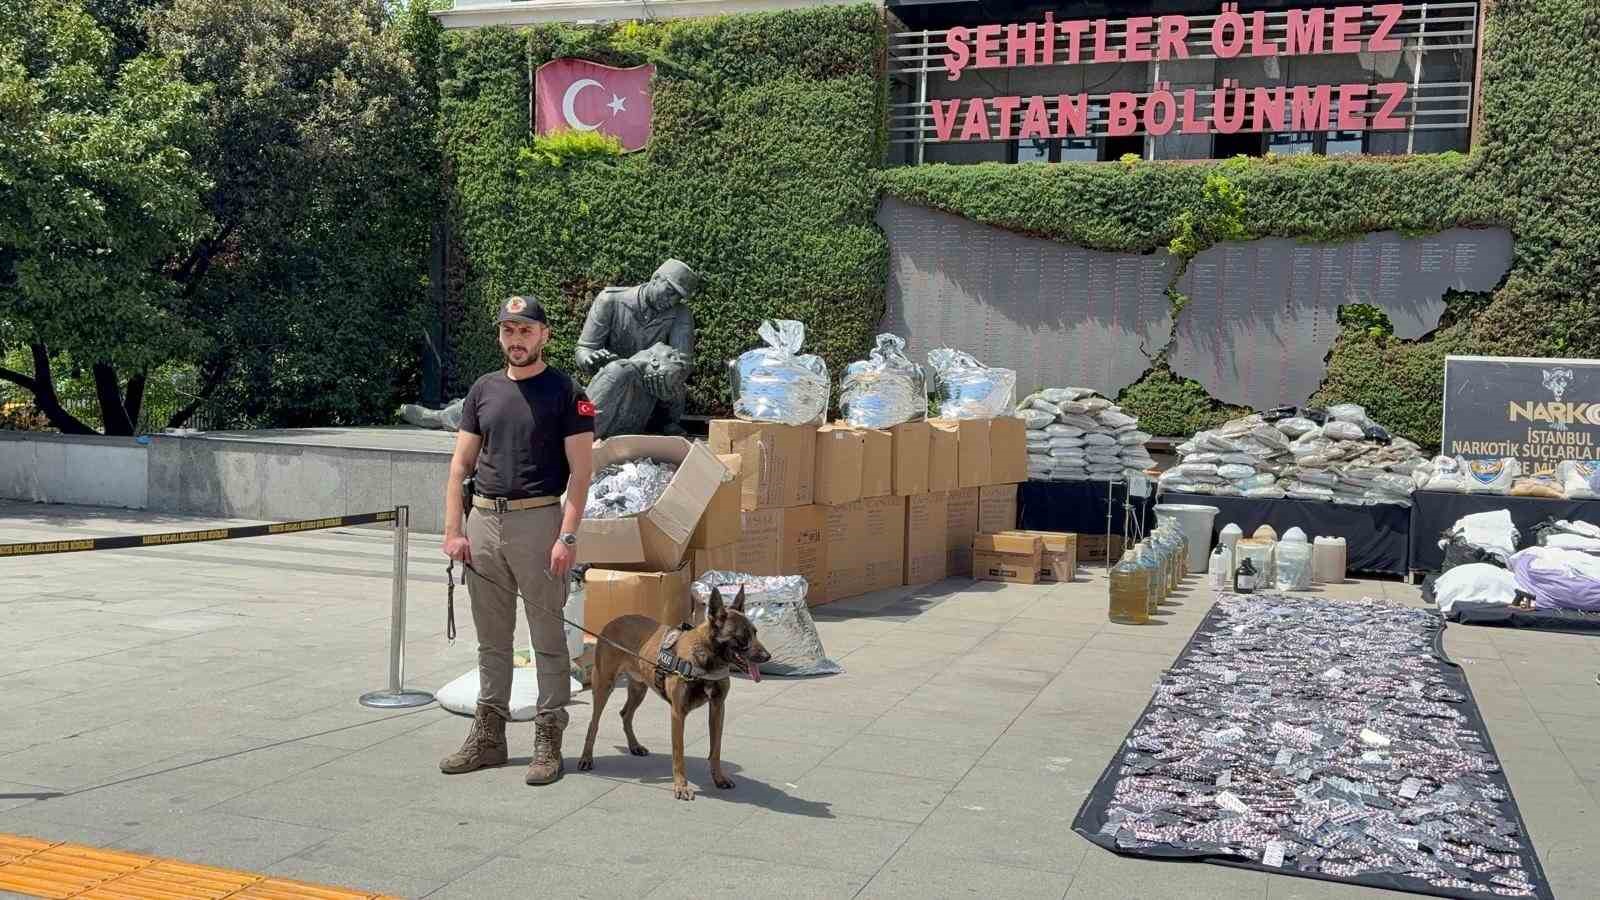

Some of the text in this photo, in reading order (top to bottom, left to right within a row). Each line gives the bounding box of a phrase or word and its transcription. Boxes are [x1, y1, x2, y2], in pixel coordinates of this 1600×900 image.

[944, 2, 1403, 80] ŞEHİTLER ÖLMEZ
[931, 79, 1408, 141] VATAN BÖLÜNMEZ
[1452, 440, 1520, 457] NARKOTİK
[1522, 445, 1593, 463] SUÇLARLA
[1527, 427, 1594, 446] İSTANBUL
